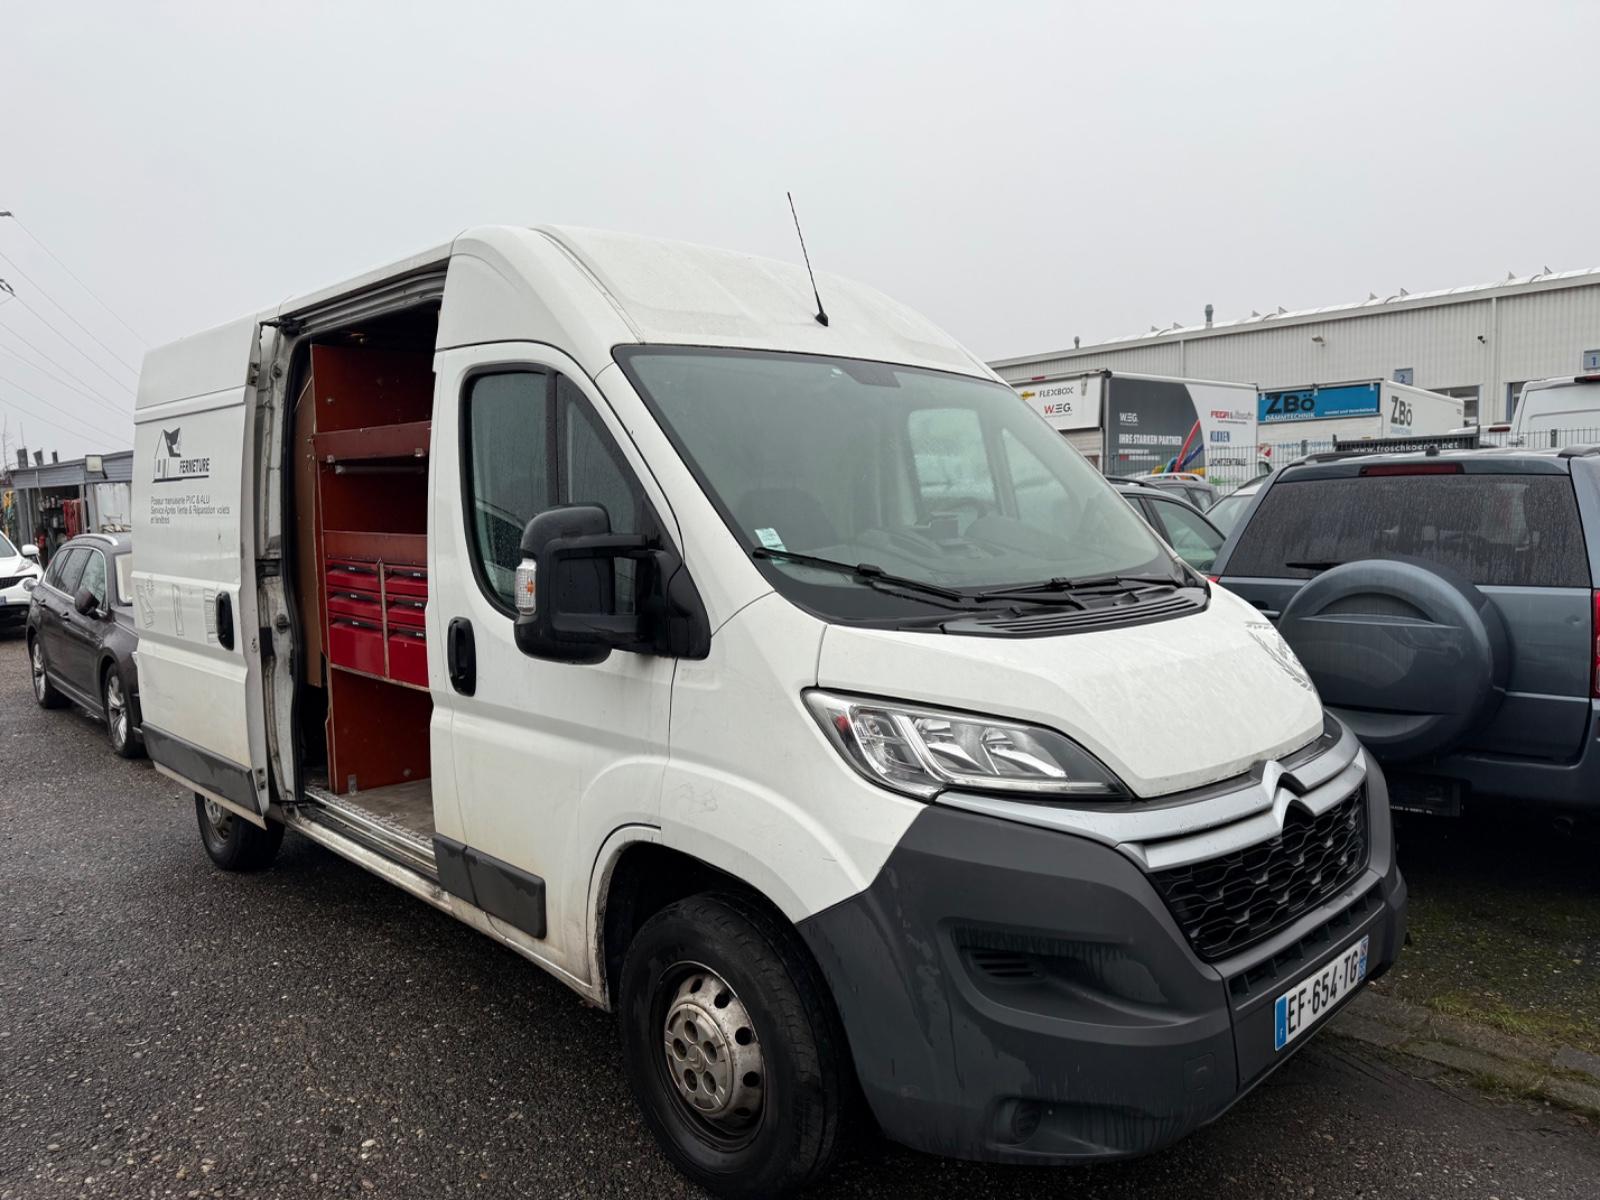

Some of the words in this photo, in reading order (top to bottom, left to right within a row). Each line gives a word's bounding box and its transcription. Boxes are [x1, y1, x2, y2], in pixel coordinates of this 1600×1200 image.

[1040, 387, 1074, 398] FLEXBOX
[1265, 392, 1316, 414] ZBö
[1265, 411, 1316, 422] DÄMMTECHNIK
[1158, 435, 1183, 446] PARTNER
[1352, 441, 1460, 454] www.froschkoen.net
[179, 458, 209, 474] FERMETURE
[1288, 949, 1359, 1035] EF-654-TG
